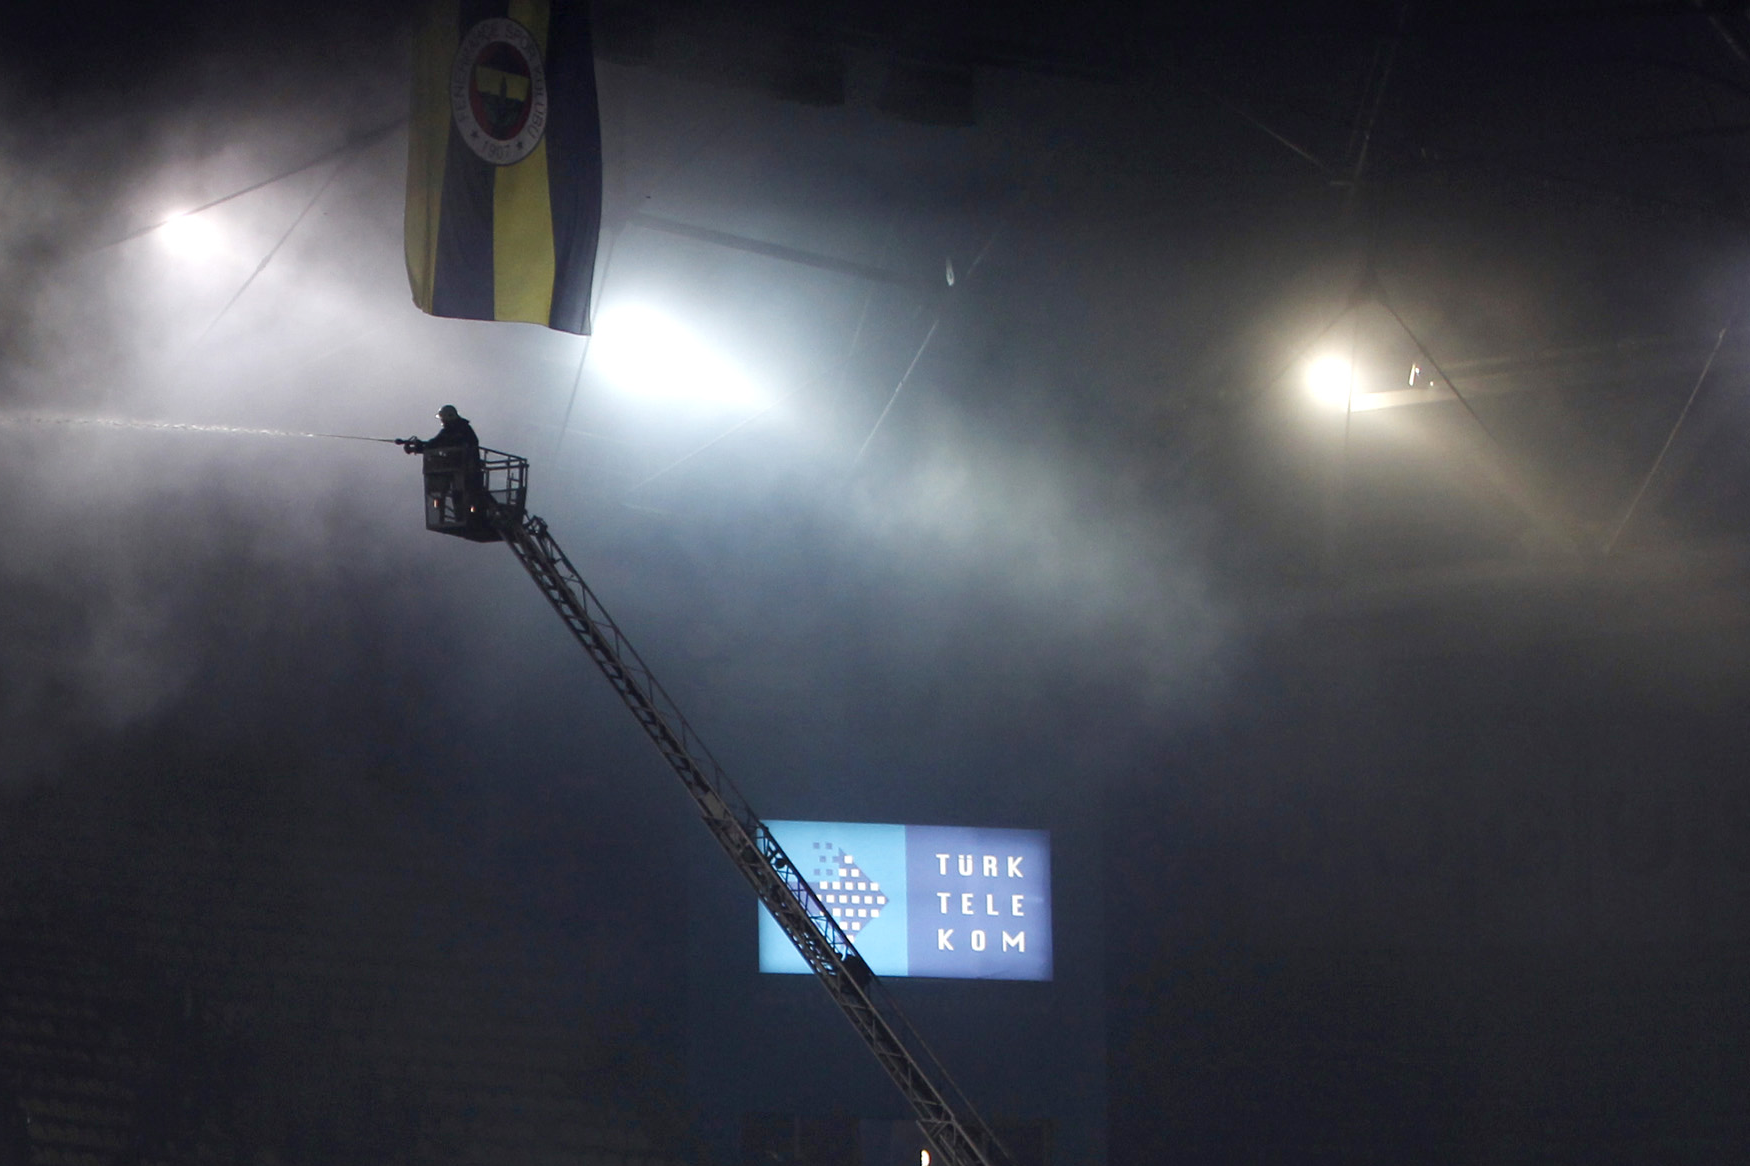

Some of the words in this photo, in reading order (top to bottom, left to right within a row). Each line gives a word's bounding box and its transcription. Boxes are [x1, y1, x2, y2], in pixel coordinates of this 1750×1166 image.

[935, 853, 1024, 878] TÜRK
[936, 892, 1025, 917] TELE
[937, 928, 1025, 953] KOM
